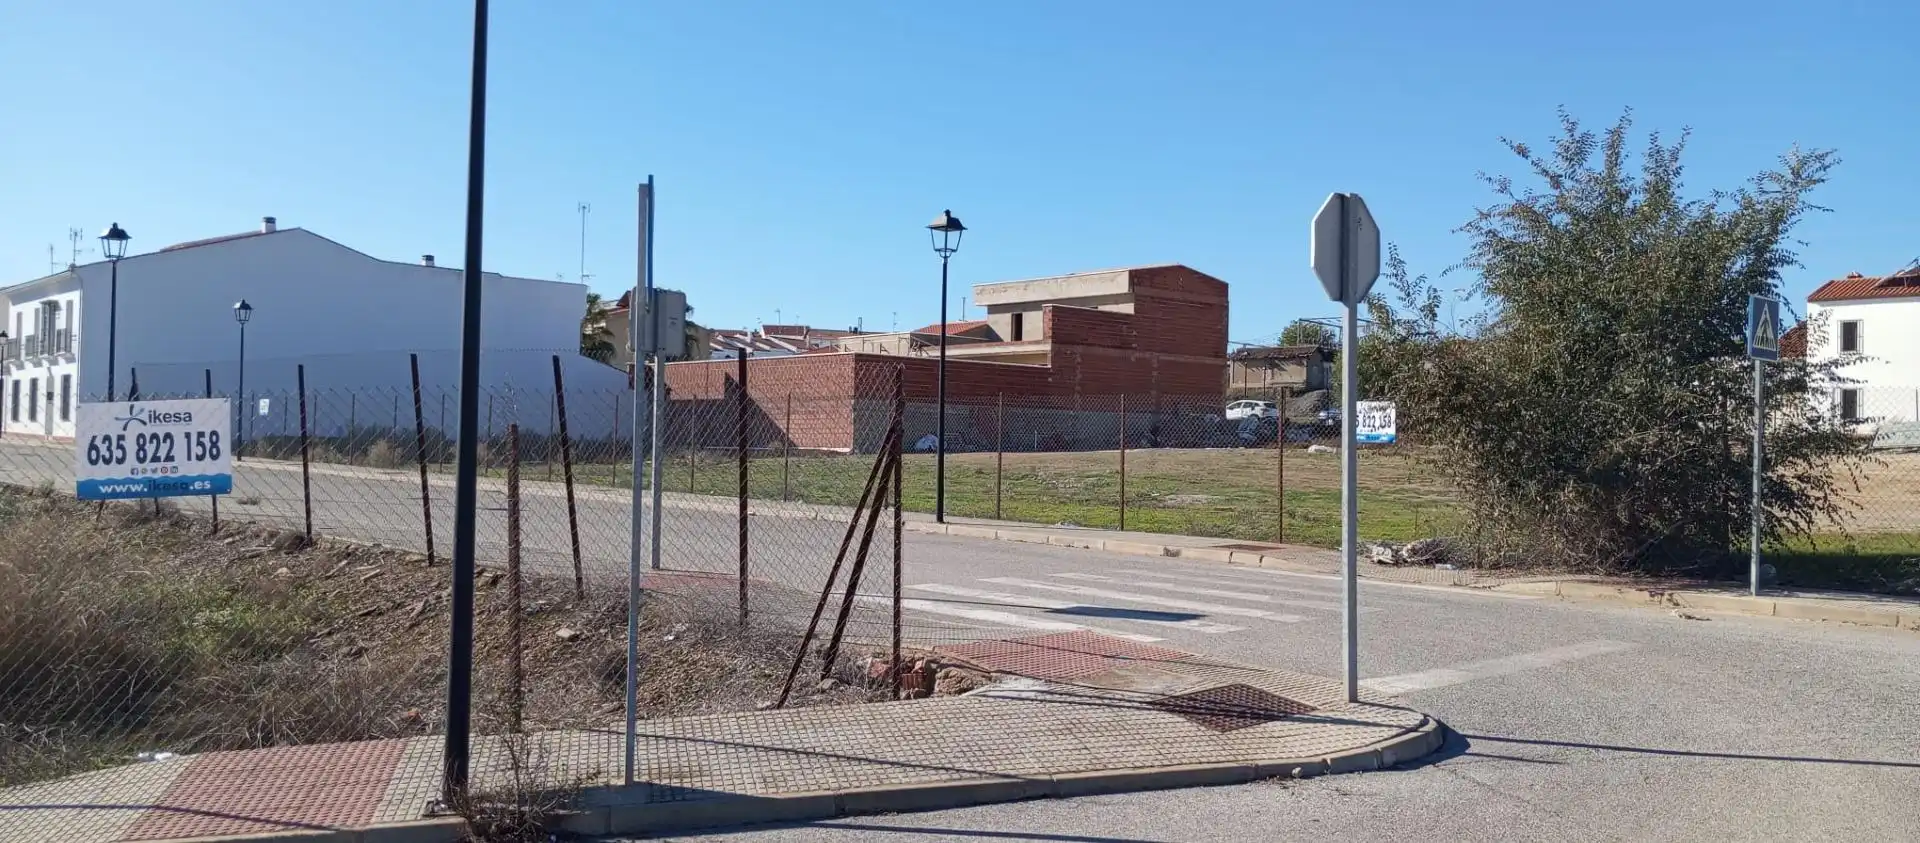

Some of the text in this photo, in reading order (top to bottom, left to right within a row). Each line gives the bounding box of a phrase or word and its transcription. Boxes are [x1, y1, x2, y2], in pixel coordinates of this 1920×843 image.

[148, 409, 193, 423] ikesa
[87, 430, 221, 466] 635 822 158
[99, 479, 211, 493] www.ikesa.es
